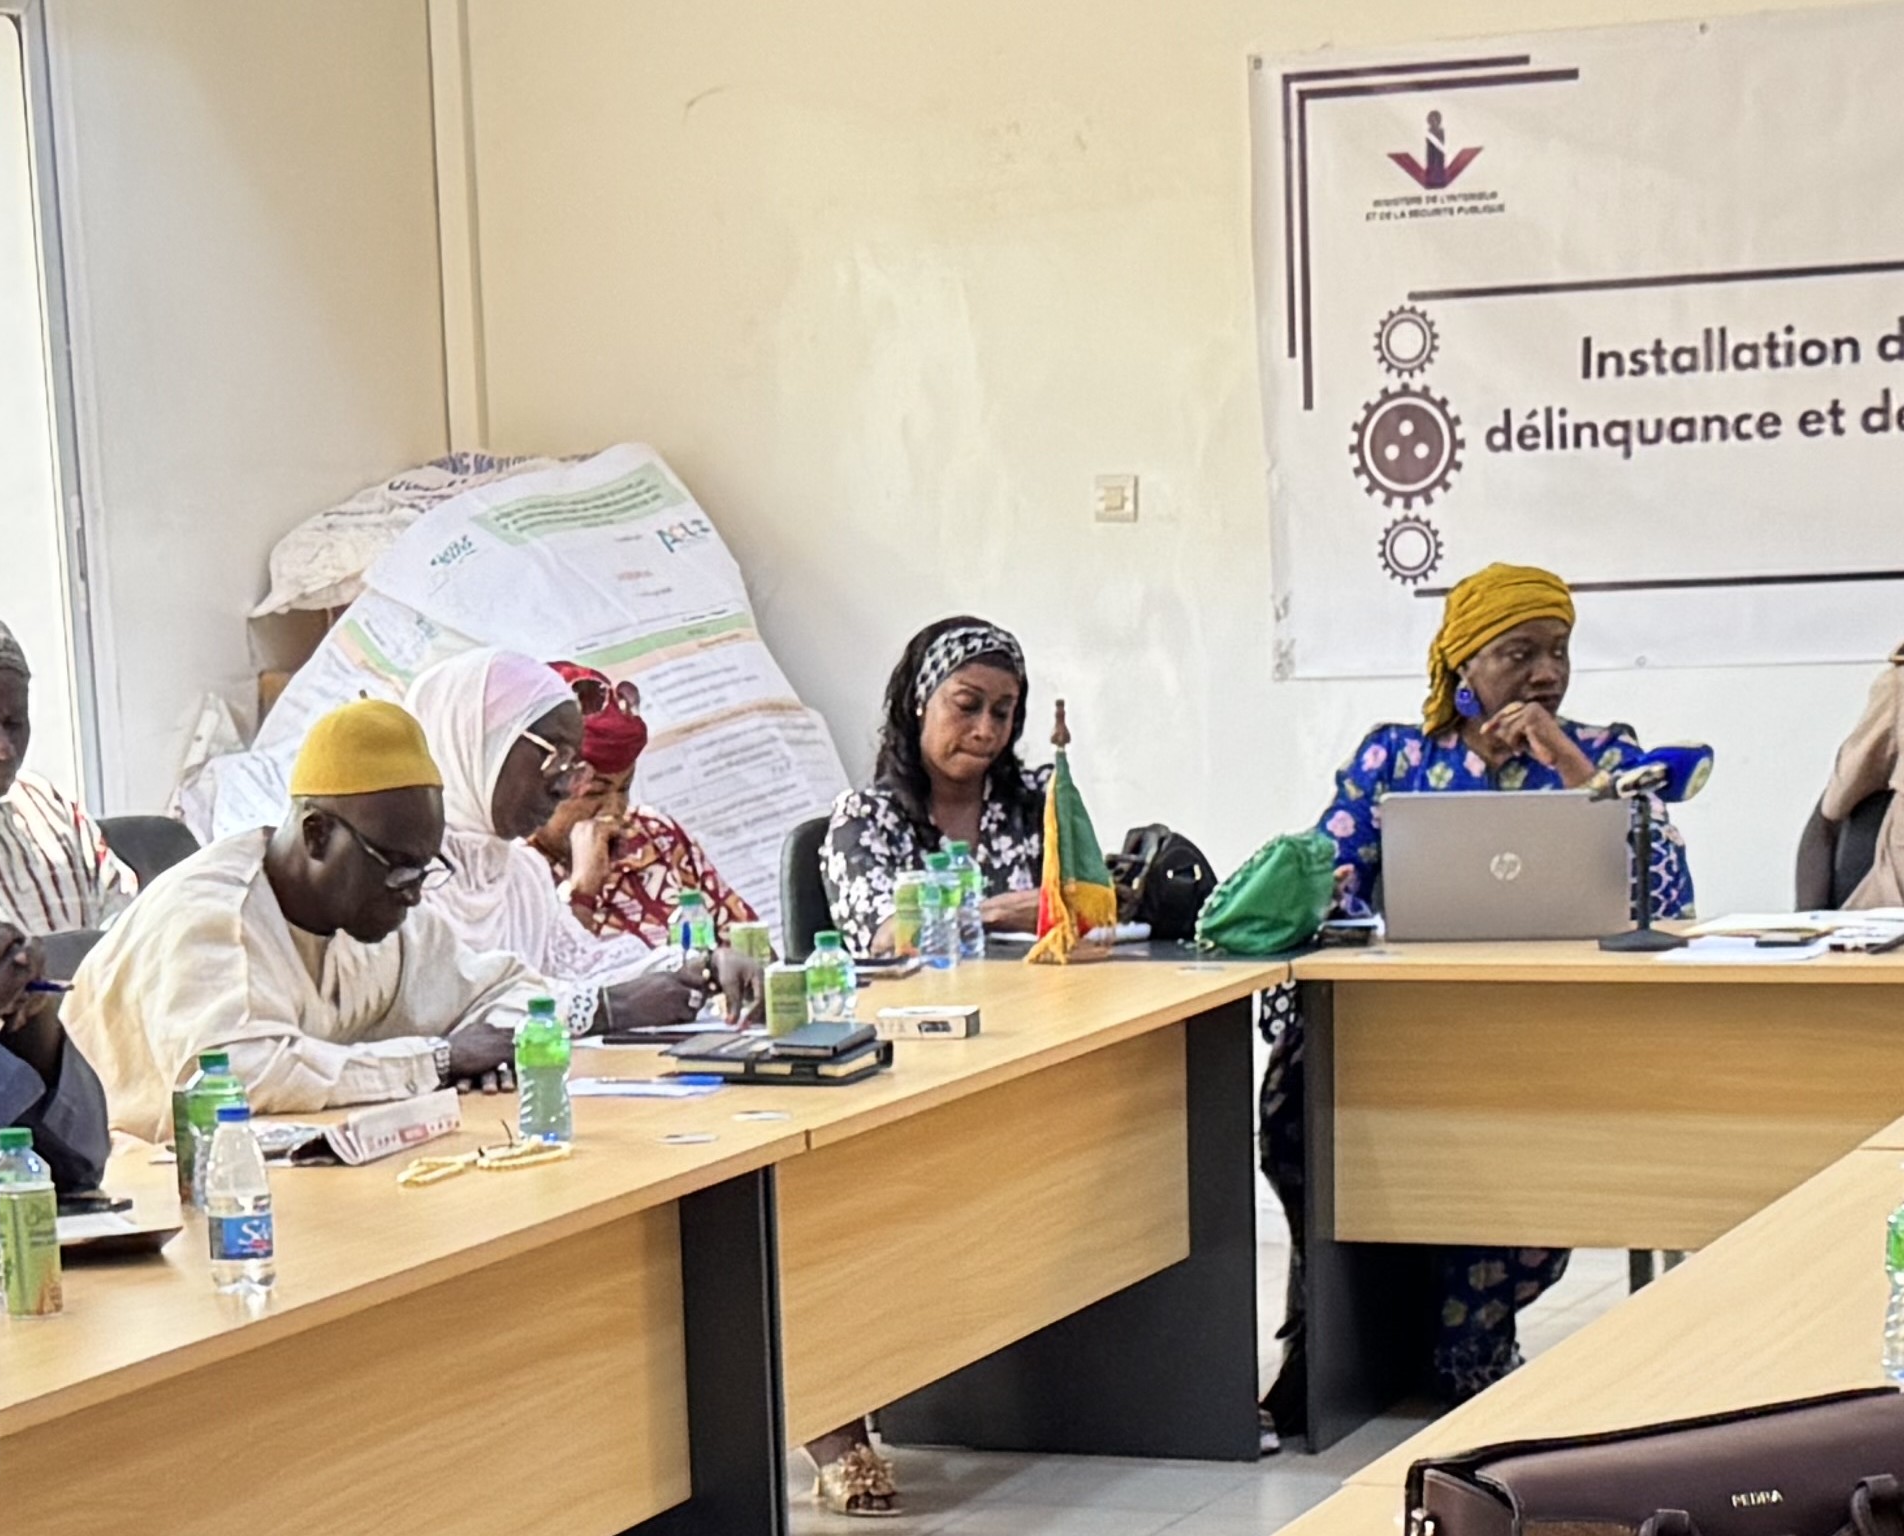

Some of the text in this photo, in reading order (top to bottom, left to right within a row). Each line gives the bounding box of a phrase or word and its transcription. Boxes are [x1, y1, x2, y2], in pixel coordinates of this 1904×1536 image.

[1582, 325, 1861, 380] Installation
[1485, 404, 1783, 460] délinquance
[1798, 398, 1846, 438] et
